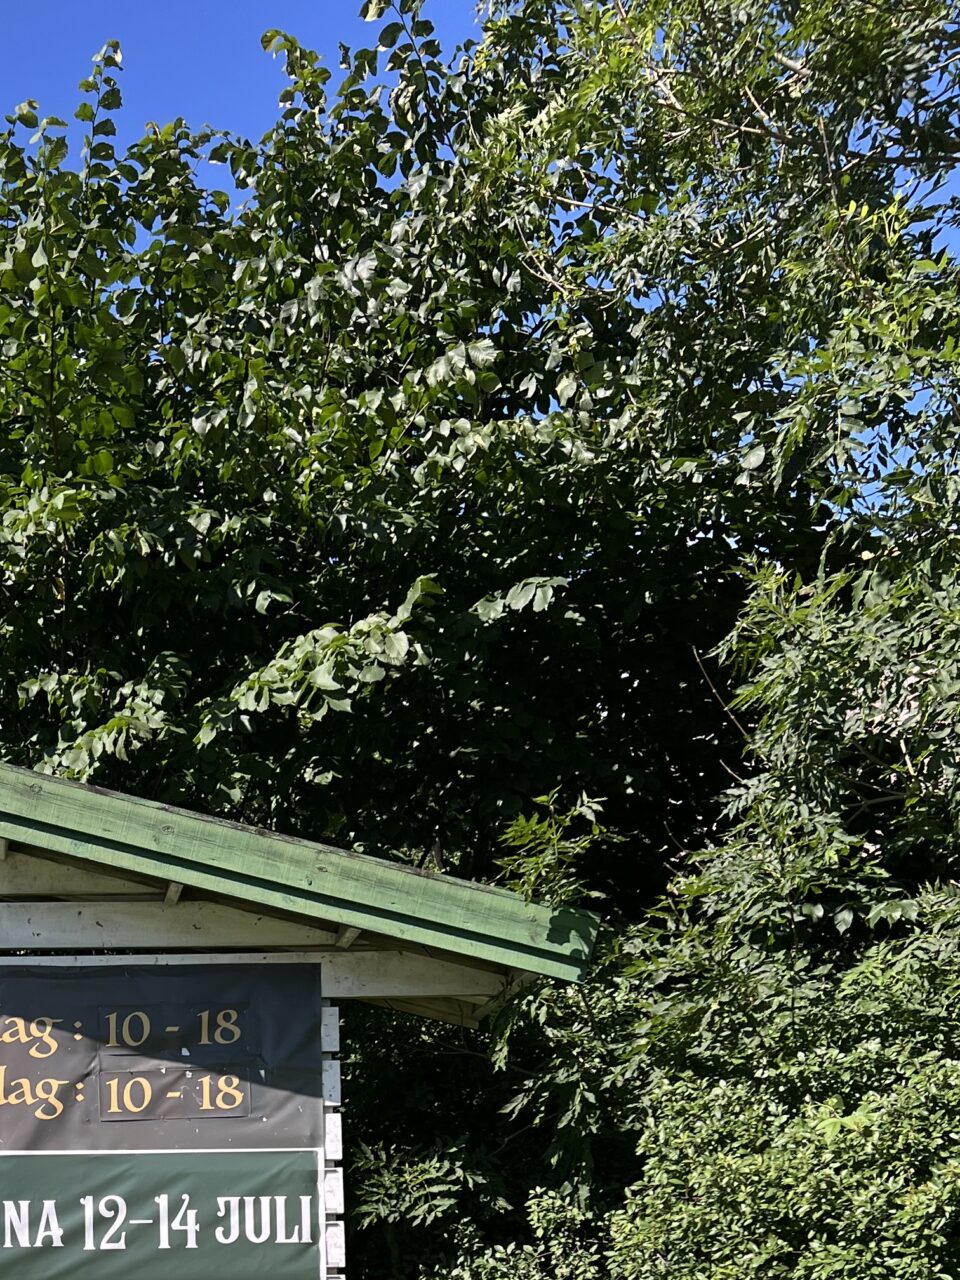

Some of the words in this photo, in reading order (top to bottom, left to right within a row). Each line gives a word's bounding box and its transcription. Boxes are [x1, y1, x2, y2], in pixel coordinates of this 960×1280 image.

[105, 1010, 151, 1047] 10
[197, 1009, 242, 1045] 18
[105, 1077, 152, 1114] 10
[198, 1074, 244, 1111] 18
[215, 1195, 313, 1246] JULI
